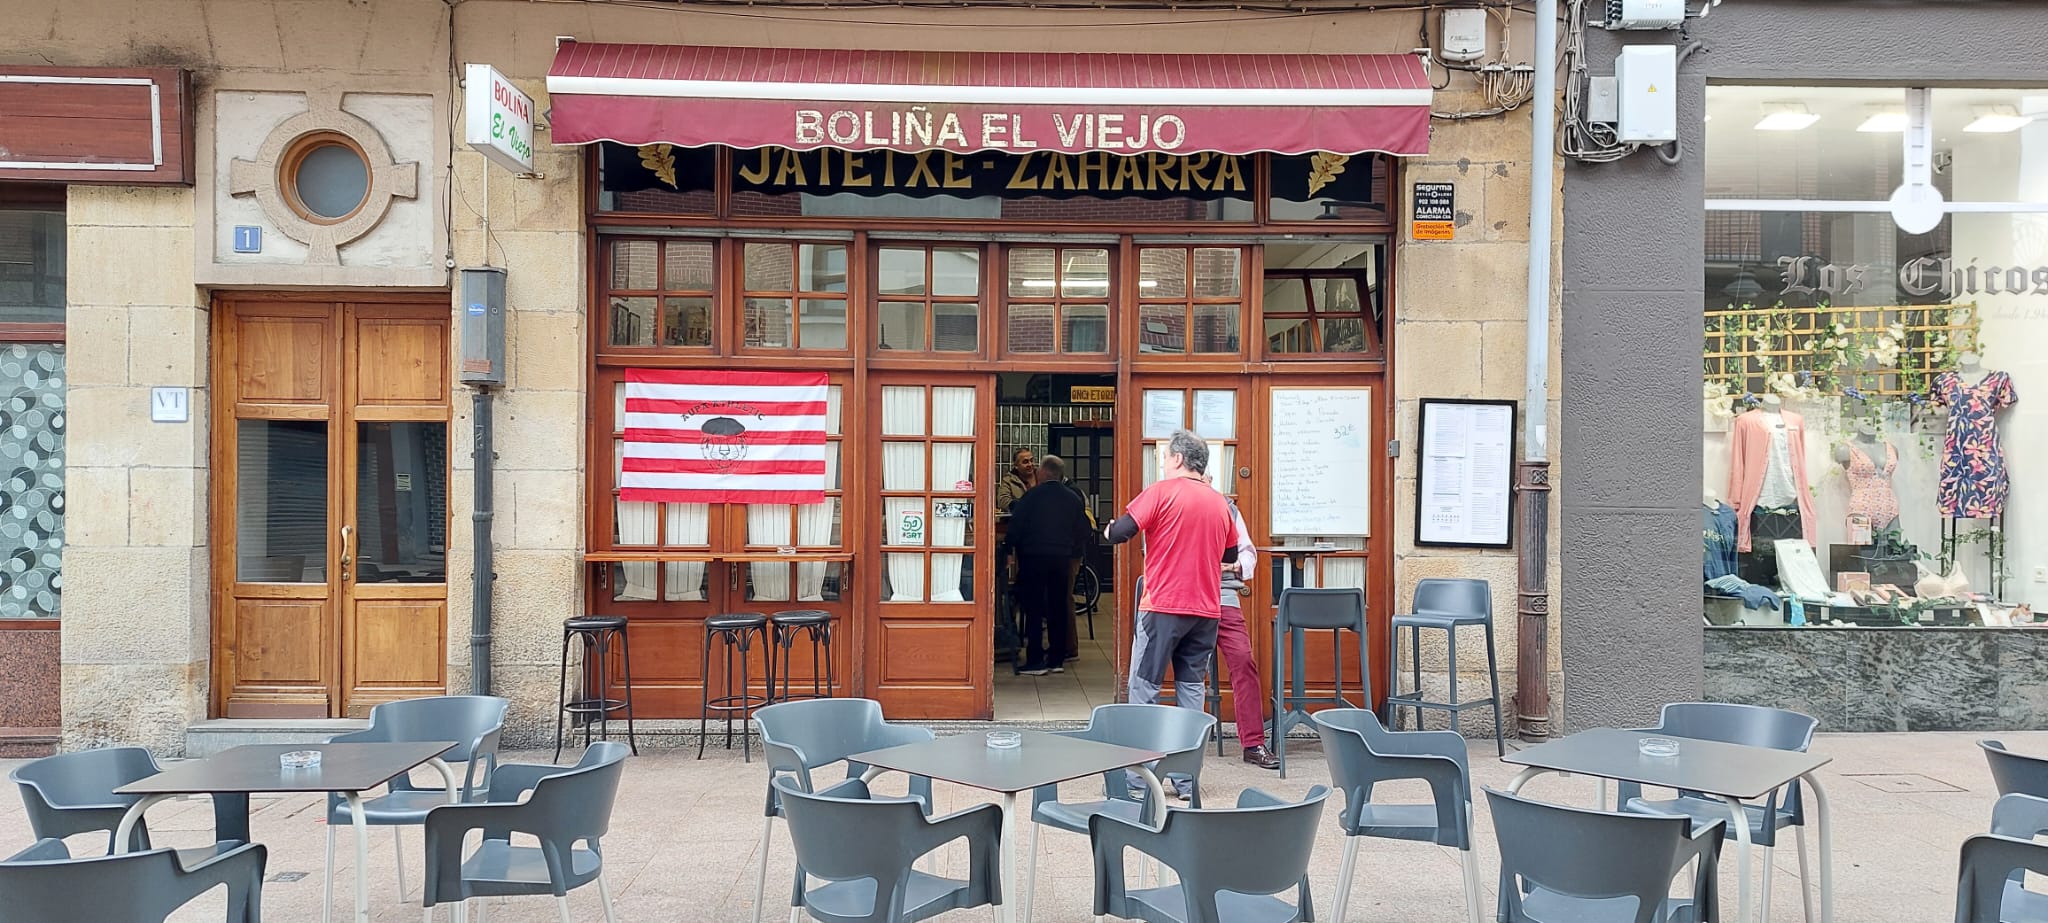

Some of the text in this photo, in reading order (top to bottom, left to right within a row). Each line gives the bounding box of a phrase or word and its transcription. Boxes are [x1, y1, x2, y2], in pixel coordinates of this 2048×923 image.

[494, 79, 529, 124] BOLIÑA
[492, 112, 531, 161] El Viejo
[795, 106, 1187, 150] BOLIÑA EL VIEJO
[738, 148, 974, 189] JATETXE
[1006, 151, 1247, 191] ZAHARRA
[1416, 206, 1451, 214] ALARMA
[242, 229, 250, 248] 1
[1776, 255, 1871, 295] Los
[156, 391, 184, 409] VT
[680, 400, 766, 422] AUPA ATHLETIC
